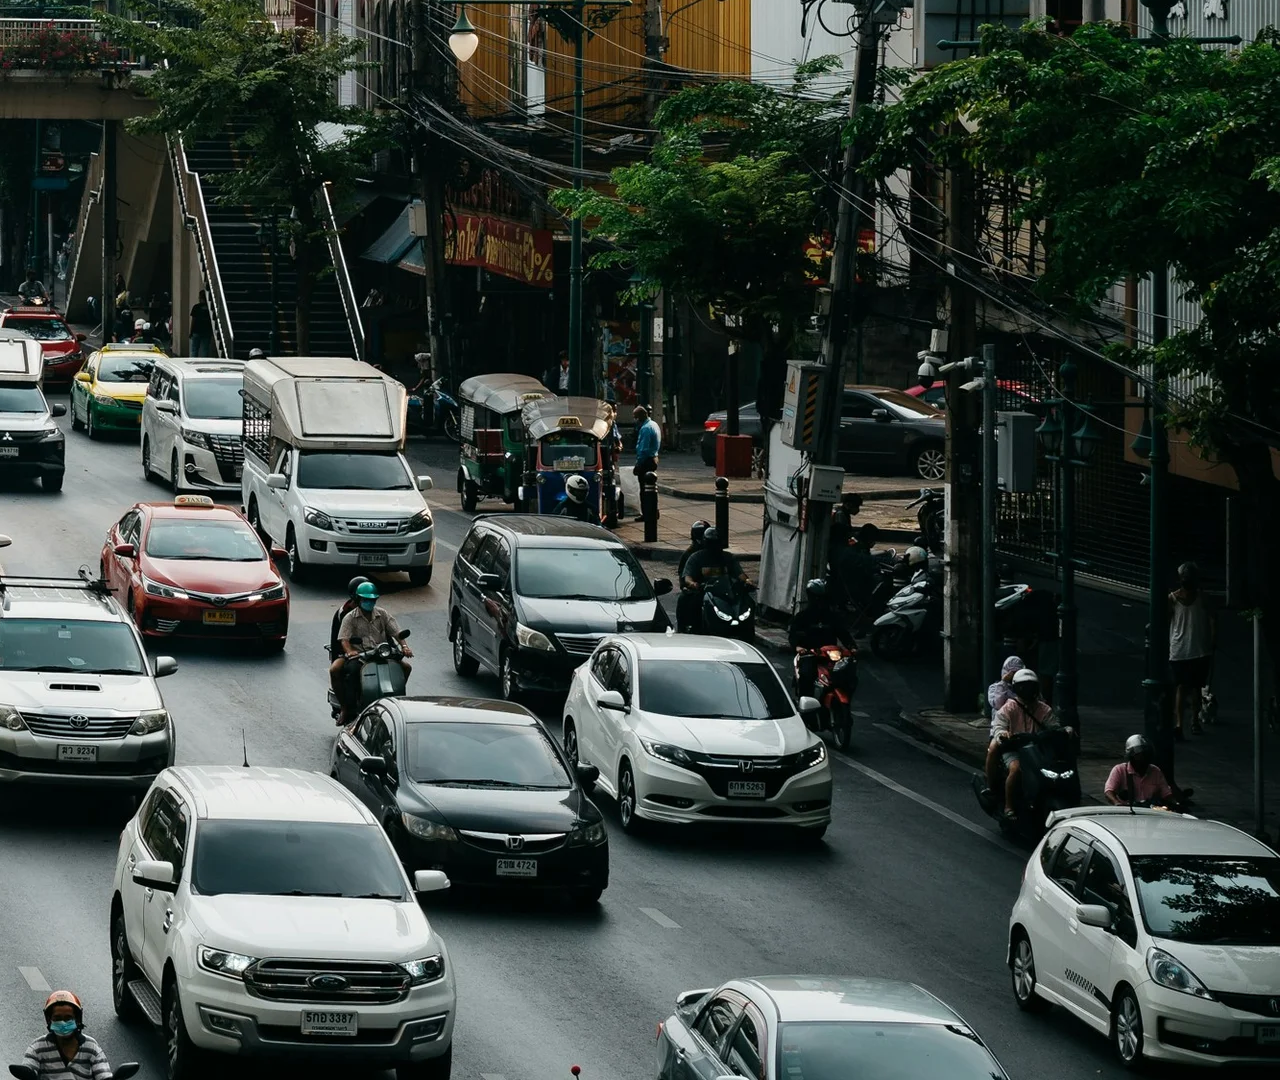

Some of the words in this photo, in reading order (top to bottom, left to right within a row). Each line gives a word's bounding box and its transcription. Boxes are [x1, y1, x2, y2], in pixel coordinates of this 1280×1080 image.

[77, 747, 95, 755] 9234
[516, 861, 536, 869] 4724
[329, 1013, 354, 1023] 3387
